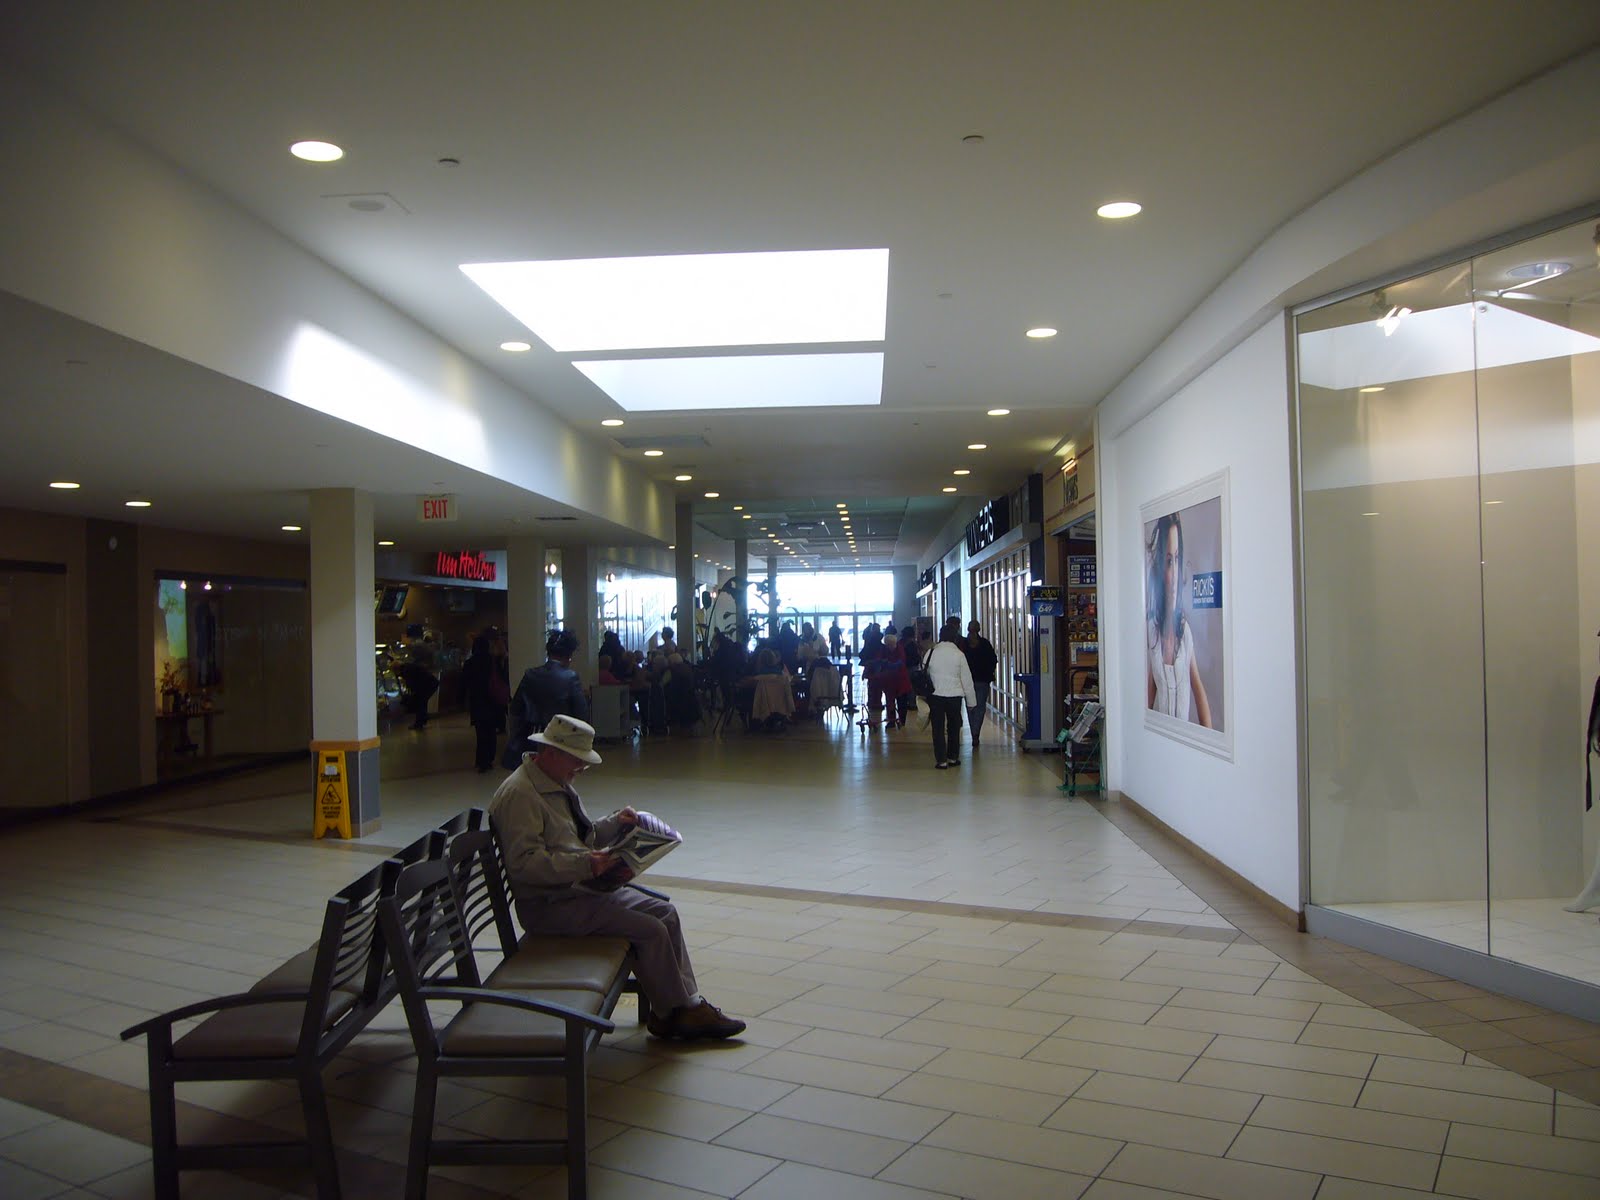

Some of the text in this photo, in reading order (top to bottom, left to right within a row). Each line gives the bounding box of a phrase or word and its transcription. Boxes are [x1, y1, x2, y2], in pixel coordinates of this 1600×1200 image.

[423, 499, 448, 519] EXIT
[436, 549, 496, 581] Tim Hortons
